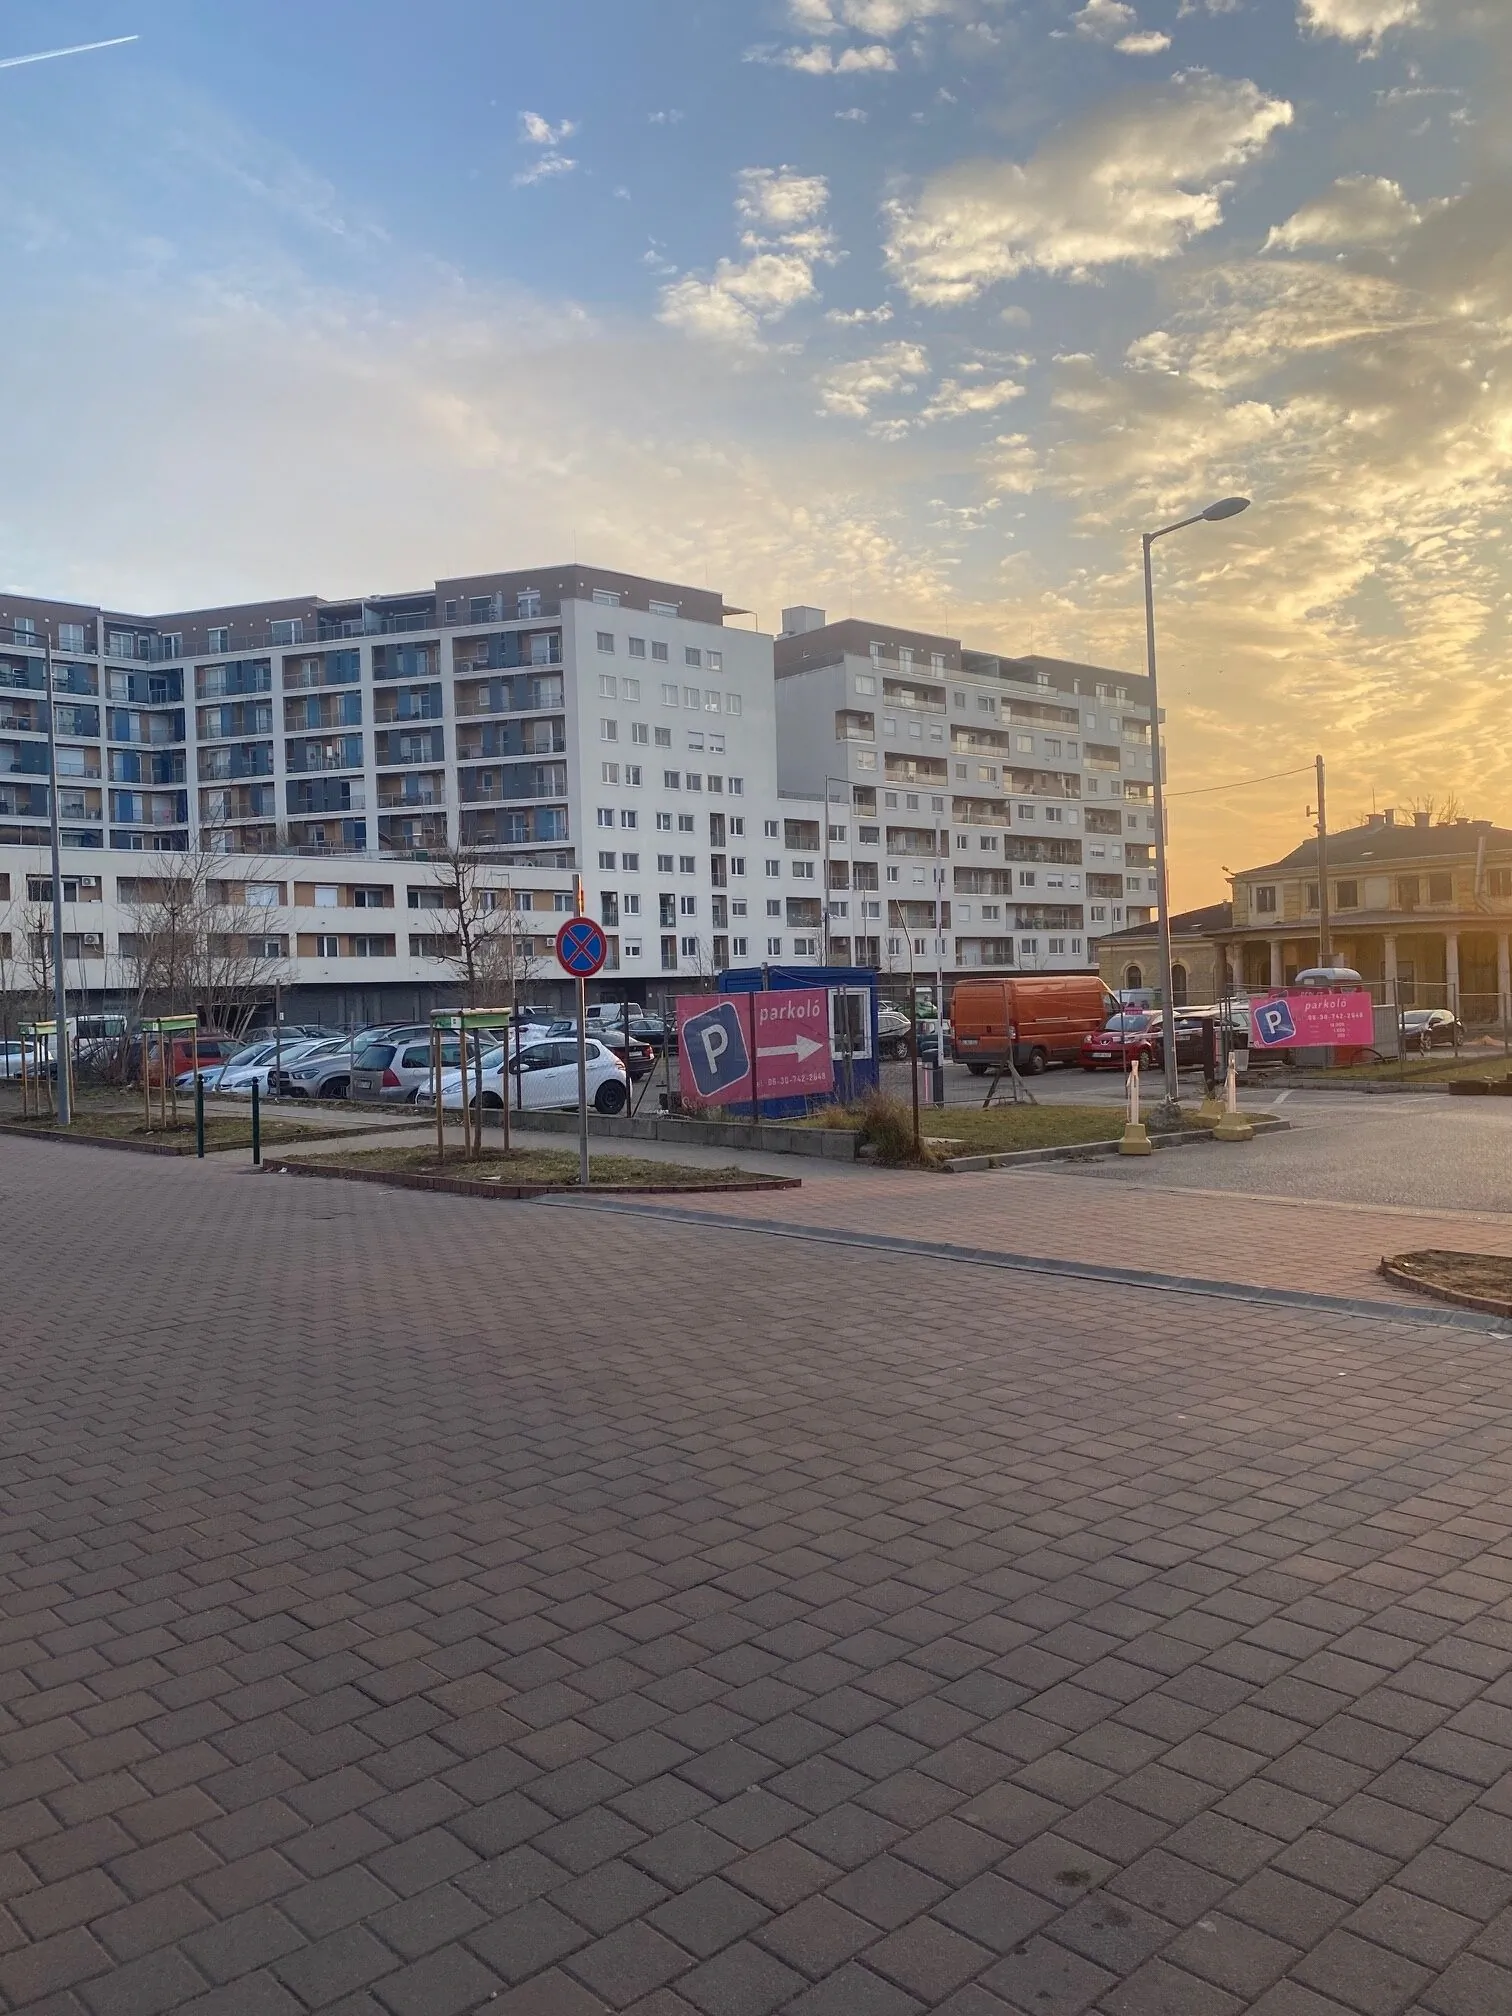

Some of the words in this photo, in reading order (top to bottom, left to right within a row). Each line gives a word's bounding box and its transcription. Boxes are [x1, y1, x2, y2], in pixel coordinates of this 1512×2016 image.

[759, 999, 821, 1025] parkoló
[1304, 998, 1347, 1011] parkoló
[1265, 1010, 1282, 1034] P
[701, 1024, 728, 1074] P
